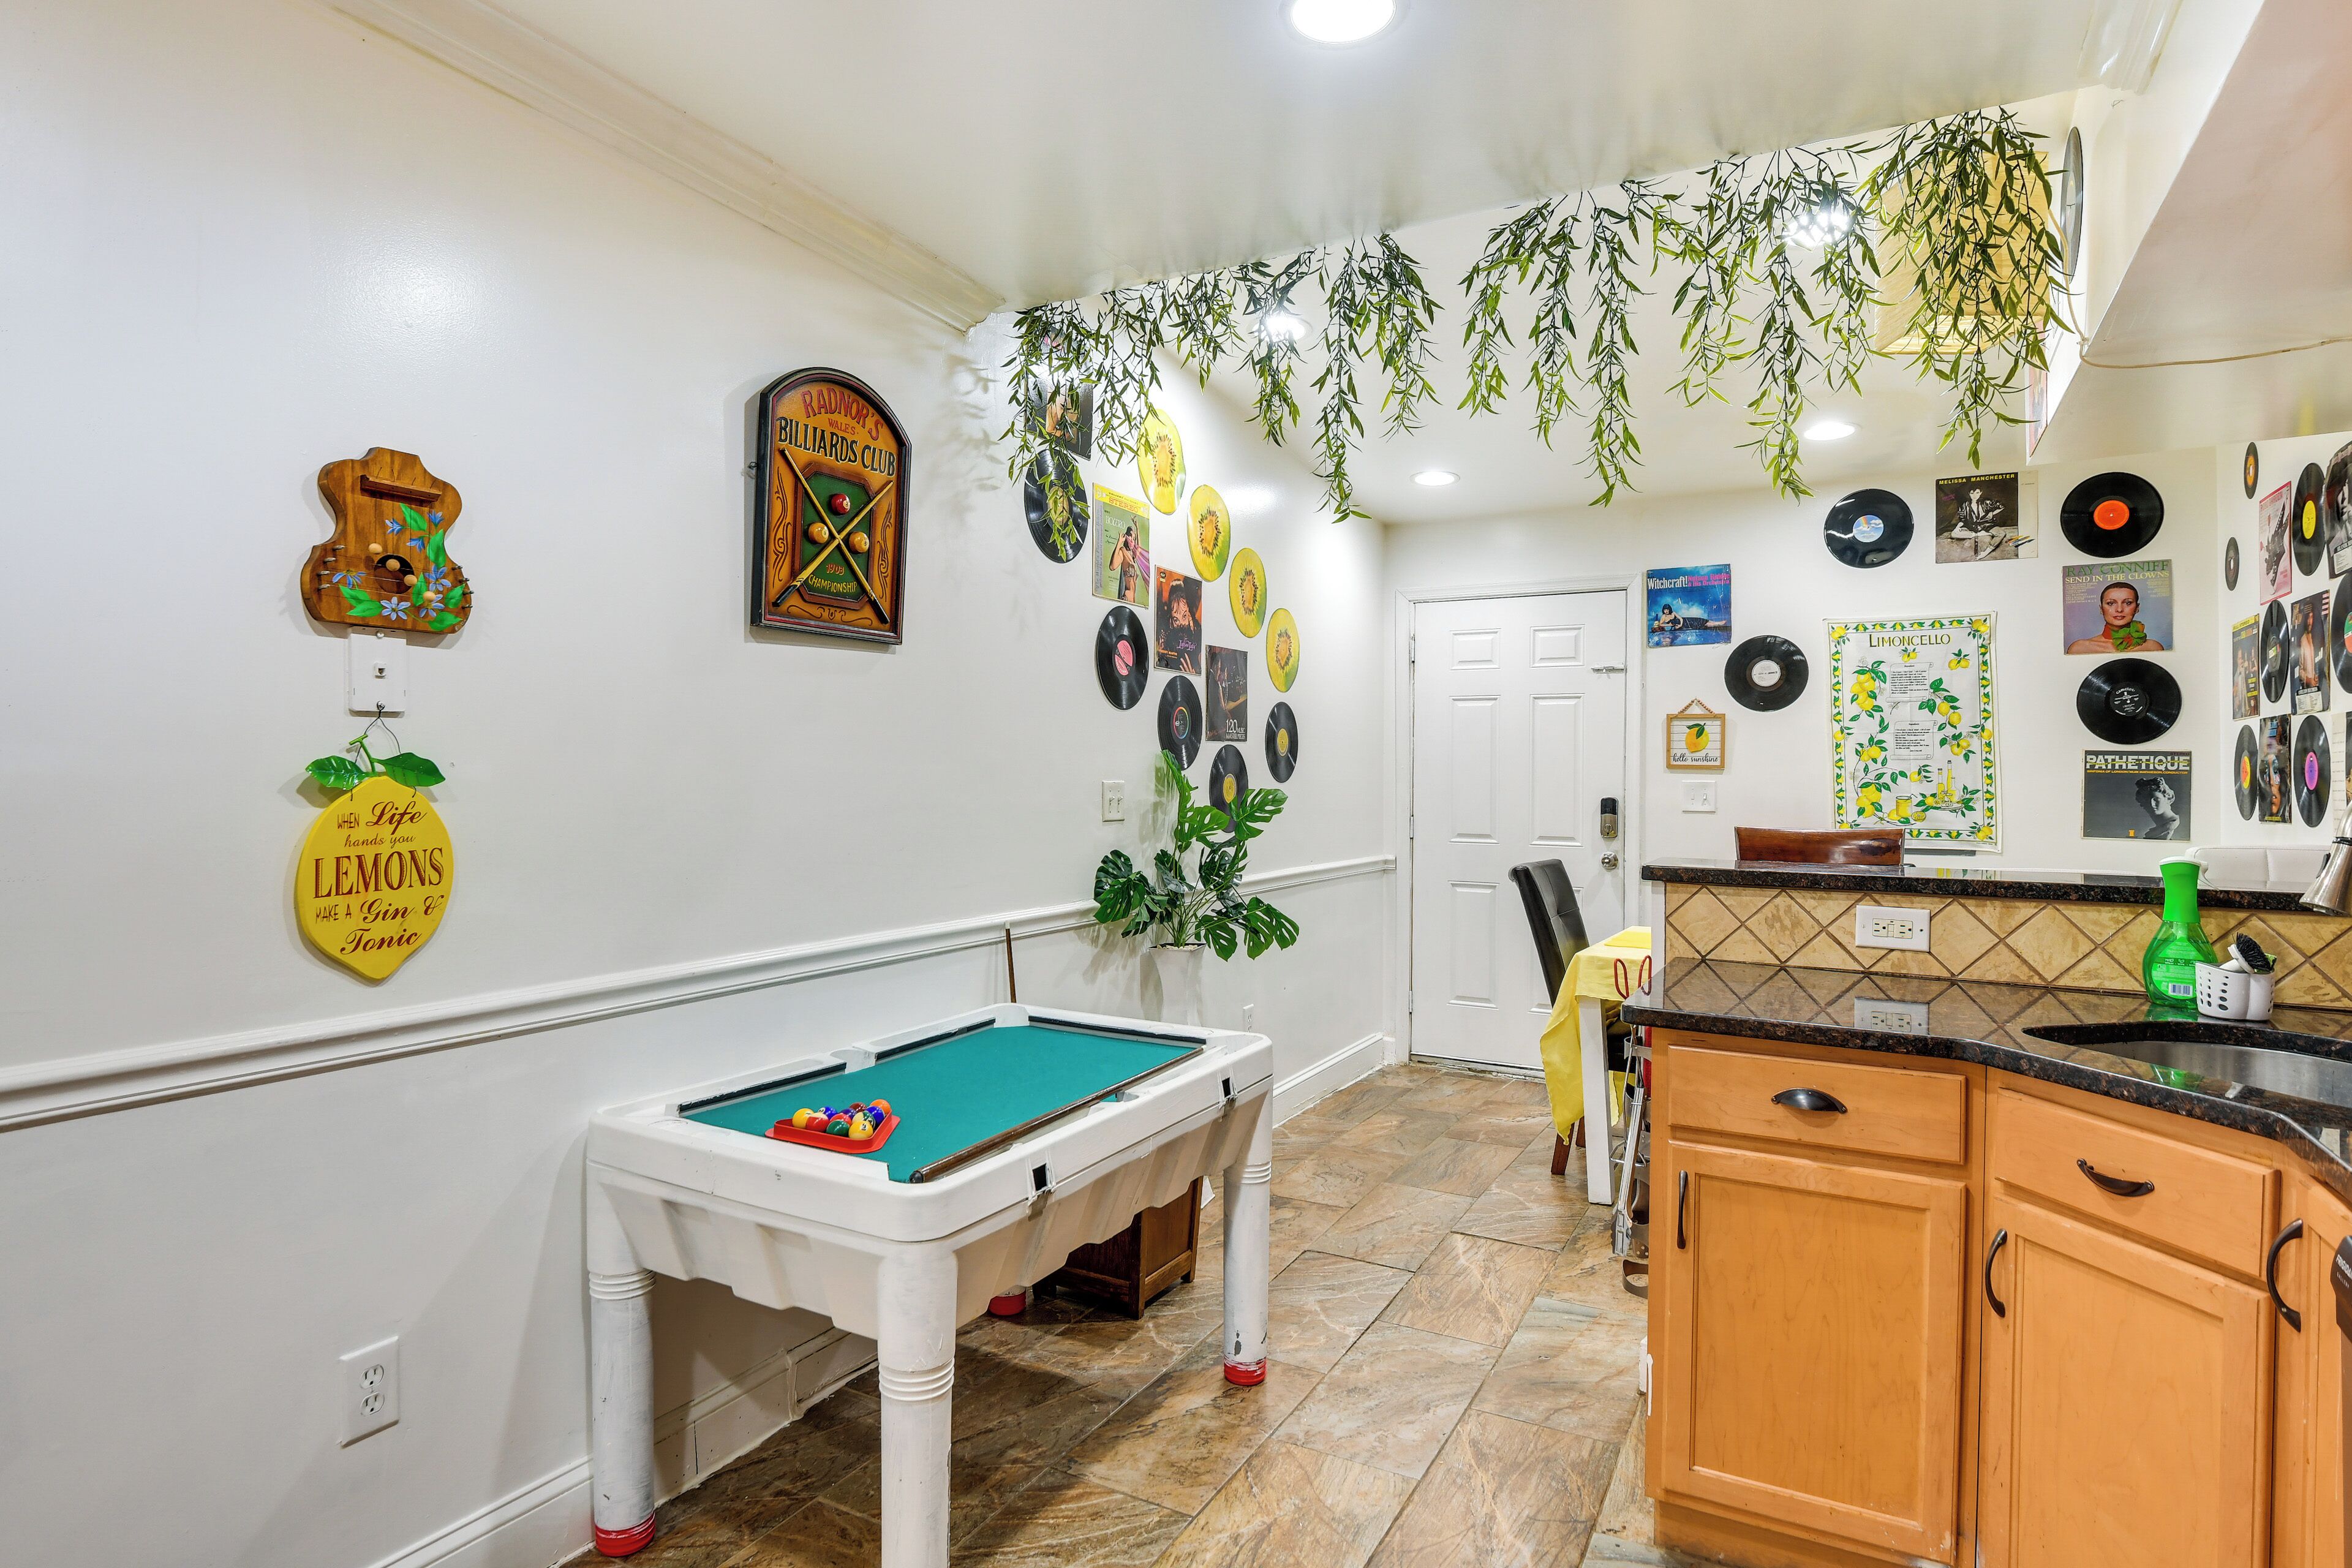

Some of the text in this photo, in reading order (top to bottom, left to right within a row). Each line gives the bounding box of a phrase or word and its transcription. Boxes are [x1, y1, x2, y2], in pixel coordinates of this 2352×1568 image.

[801, 387, 884, 441] RADNOR'S
[775, 417, 896, 478] BILLIARDS CLUB
[1970, 473, 2015, 482] MANCHESTER
[1109, 497, 1139, 513] STEREO
[1106, 515, 1126, 529] BOLERO
[2067, 560, 2169, 577] RAY CONNIFF
[2128, 571, 2169, 581] CLOWNS
[808, 573, 858, 594] CHAMPIONSHIP
[1648, 575, 1688, 590] Witchcraft!
[1869, 633, 1951, 648] LIMONCELLO
[1226, 718, 1238, 734] 120
[1673, 752, 1718, 763] hello sunshine
[2086, 755, 2190, 771] PATHETIQUE
[337, 801, 428, 835] WHEN Life
[344, 832, 416, 849] hands you
[313, 846, 444, 899] LEMONS
[315, 894, 445, 924] MAKE A Gin &
[340, 927, 422, 955] Tonic
